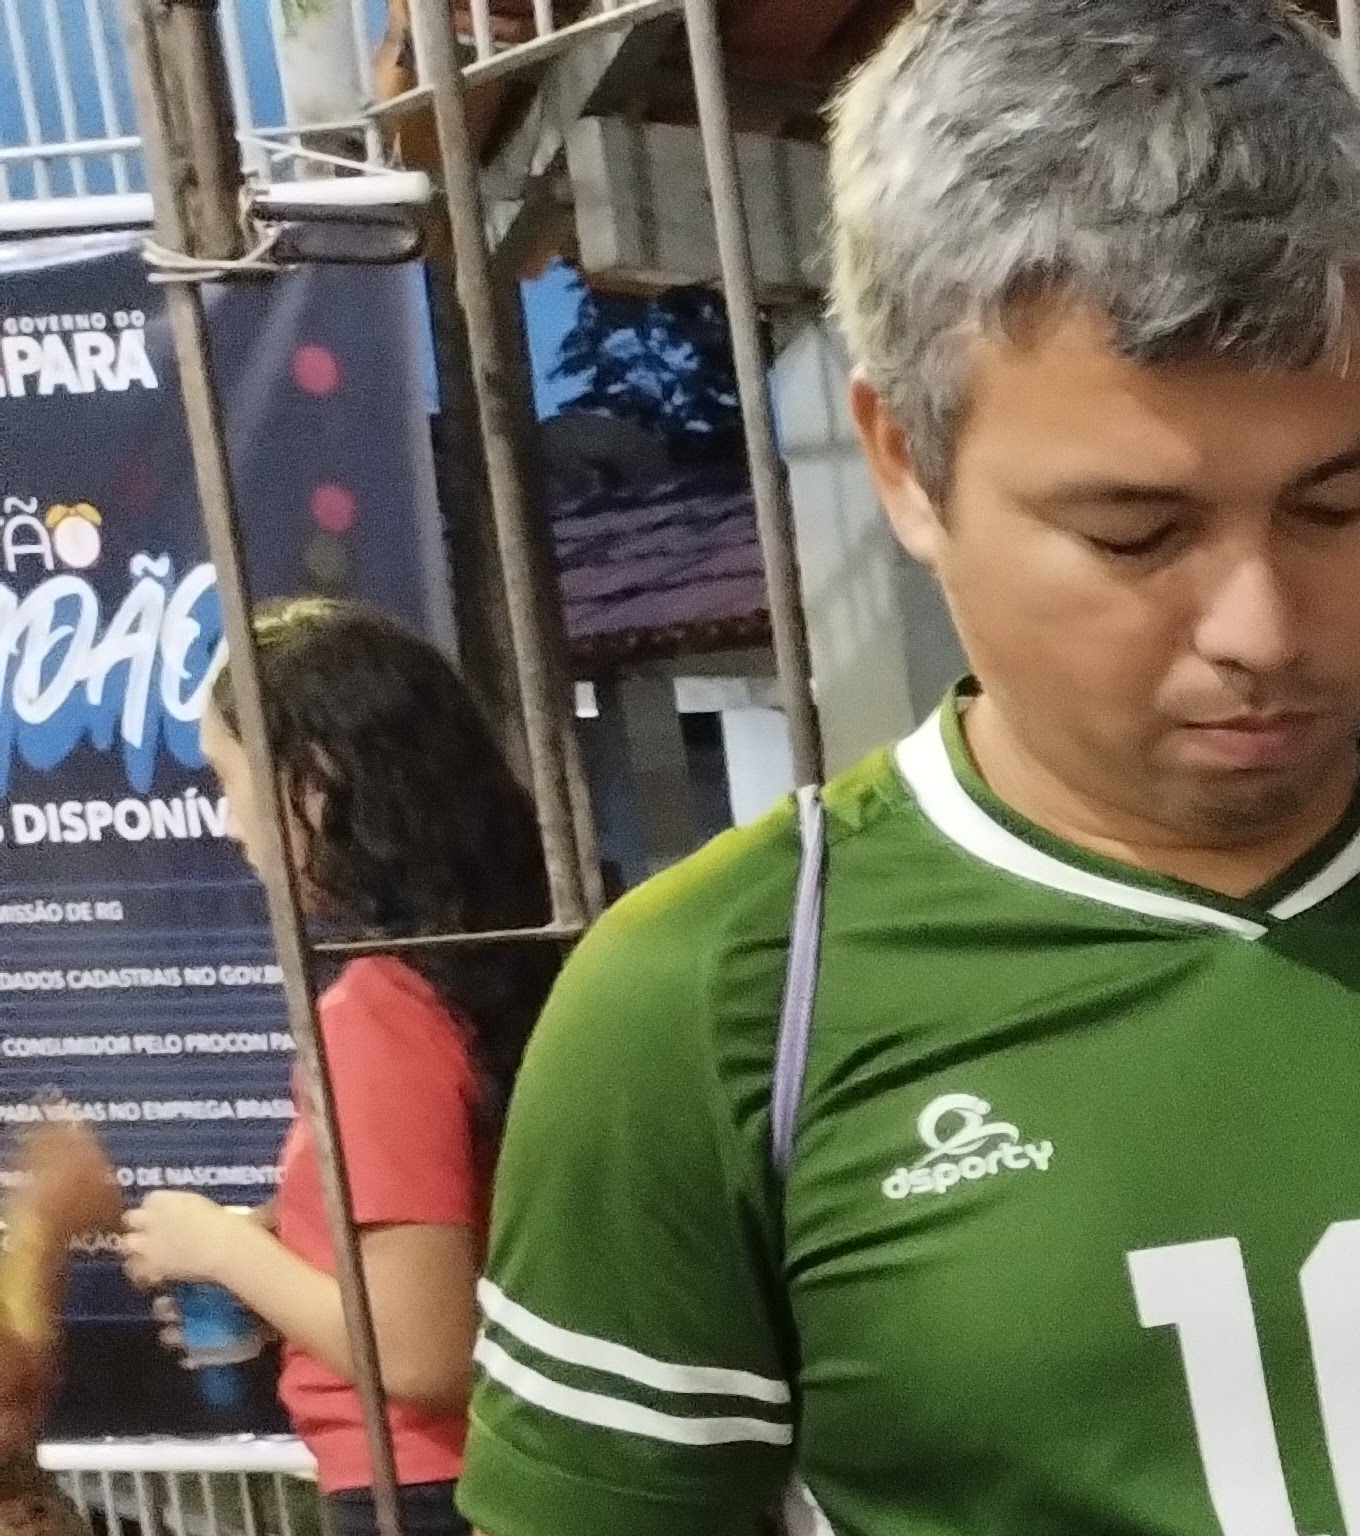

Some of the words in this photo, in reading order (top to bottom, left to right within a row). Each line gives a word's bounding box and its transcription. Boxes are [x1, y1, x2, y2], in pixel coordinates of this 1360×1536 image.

[3, 312, 107, 335] GOVERNO
[113, 310, 146, 328] DO
[0, 553, 229, 748] DÃO
[12, 787, 230, 844] DISPONÍV
[65, 901, 94, 921] DE
[95, 900, 123, 920] RG
[0, 970, 66, 990] DADOS
[67, 966, 182, 988] CADASTRAIS
[184, 965, 216, 985] NO
[2, 1036, 131, 1056] CONSUMIDOR
[132, 1034, 182, 1053] PELO
[184, 1033, 268, 1052] PROCON
[108, 1101, 141, 1120] NO
[165, 1166, 288, 1184] NASCIMENTO
[881, 1140, 1054, 1199] dsporty
